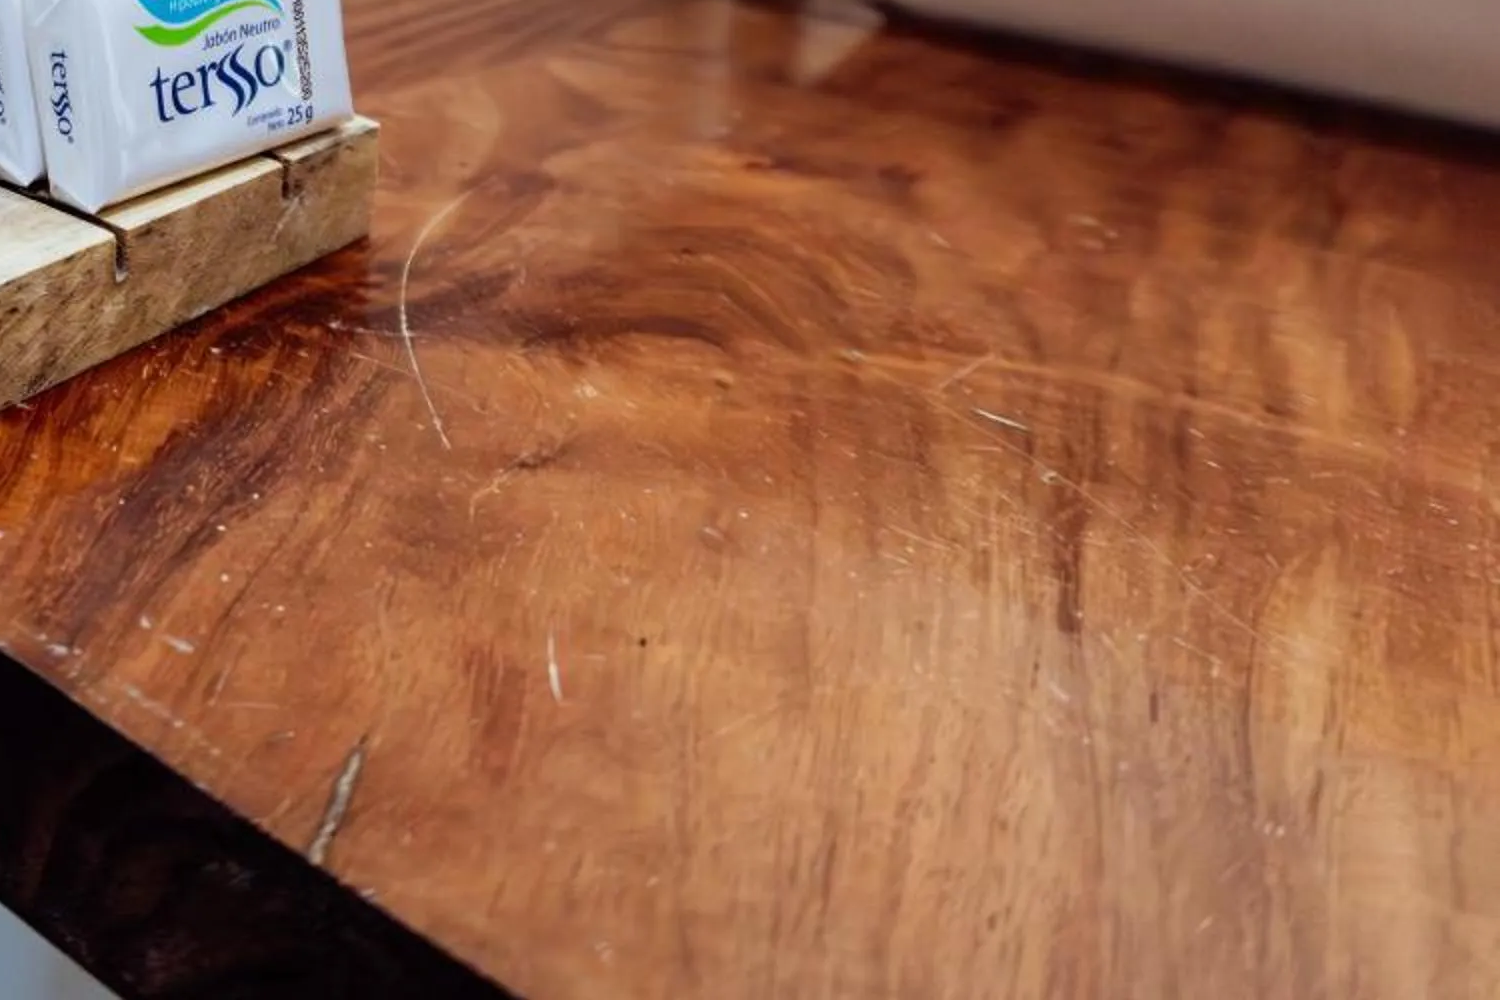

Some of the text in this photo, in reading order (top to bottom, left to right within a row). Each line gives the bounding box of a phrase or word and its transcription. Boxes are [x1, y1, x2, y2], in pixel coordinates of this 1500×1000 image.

[203, 17, 281, 52] Jabón Neutro
[50, 49, 73, 138] tersso
[148, 43, 286, 124] tersso
[287, 103, 303, 126] 25
[304, 101, 314, 126] g
